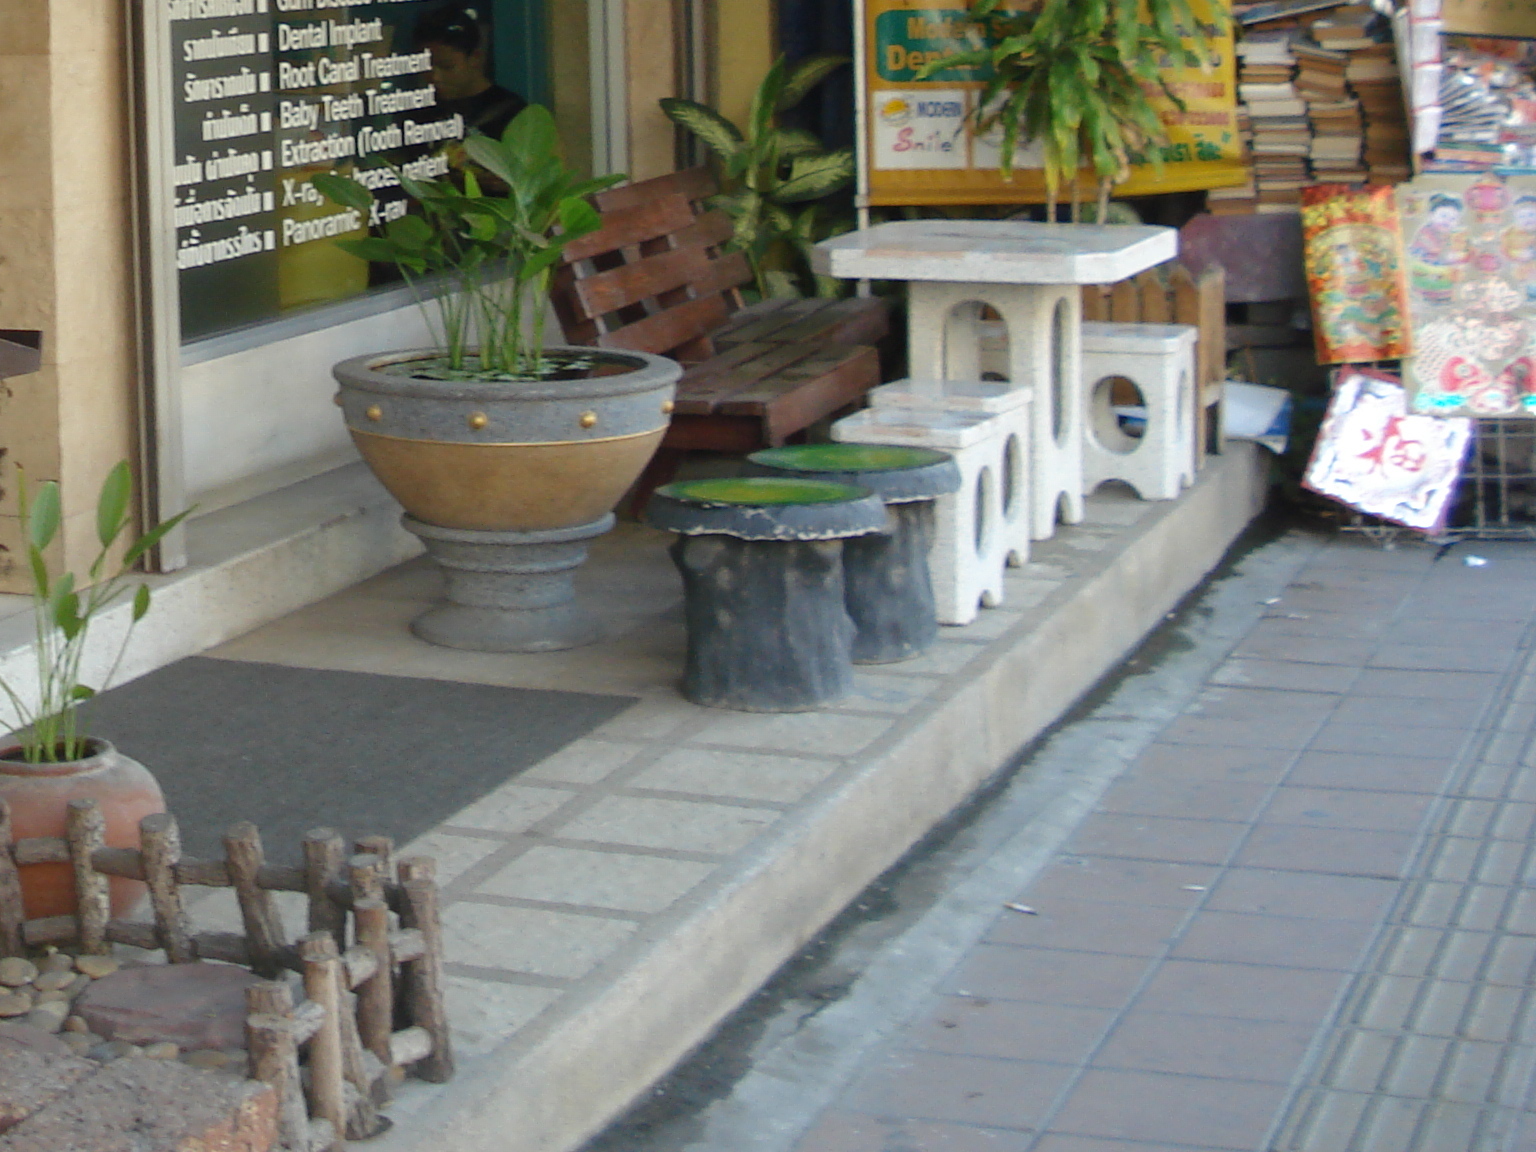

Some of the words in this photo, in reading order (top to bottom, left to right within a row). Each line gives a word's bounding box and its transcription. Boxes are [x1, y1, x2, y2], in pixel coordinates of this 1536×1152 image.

[278, 19, 328, 52] Dental
[328, 16, 383, 50] Implant
[278, 61, 318, 90] Root
[317, 54, 361, 86] Canal
[362, 47, 433, 80] Treatment
[279, 100, 320, 131] Baby
[322, 93, 364, 123] Teeth
[365, 83, 437, 117] Treatment
[281, 133, 356, 168] Extraction
[358, 122, 404, 159] (Tooth
[403, 112, 465, 147] Removal)
